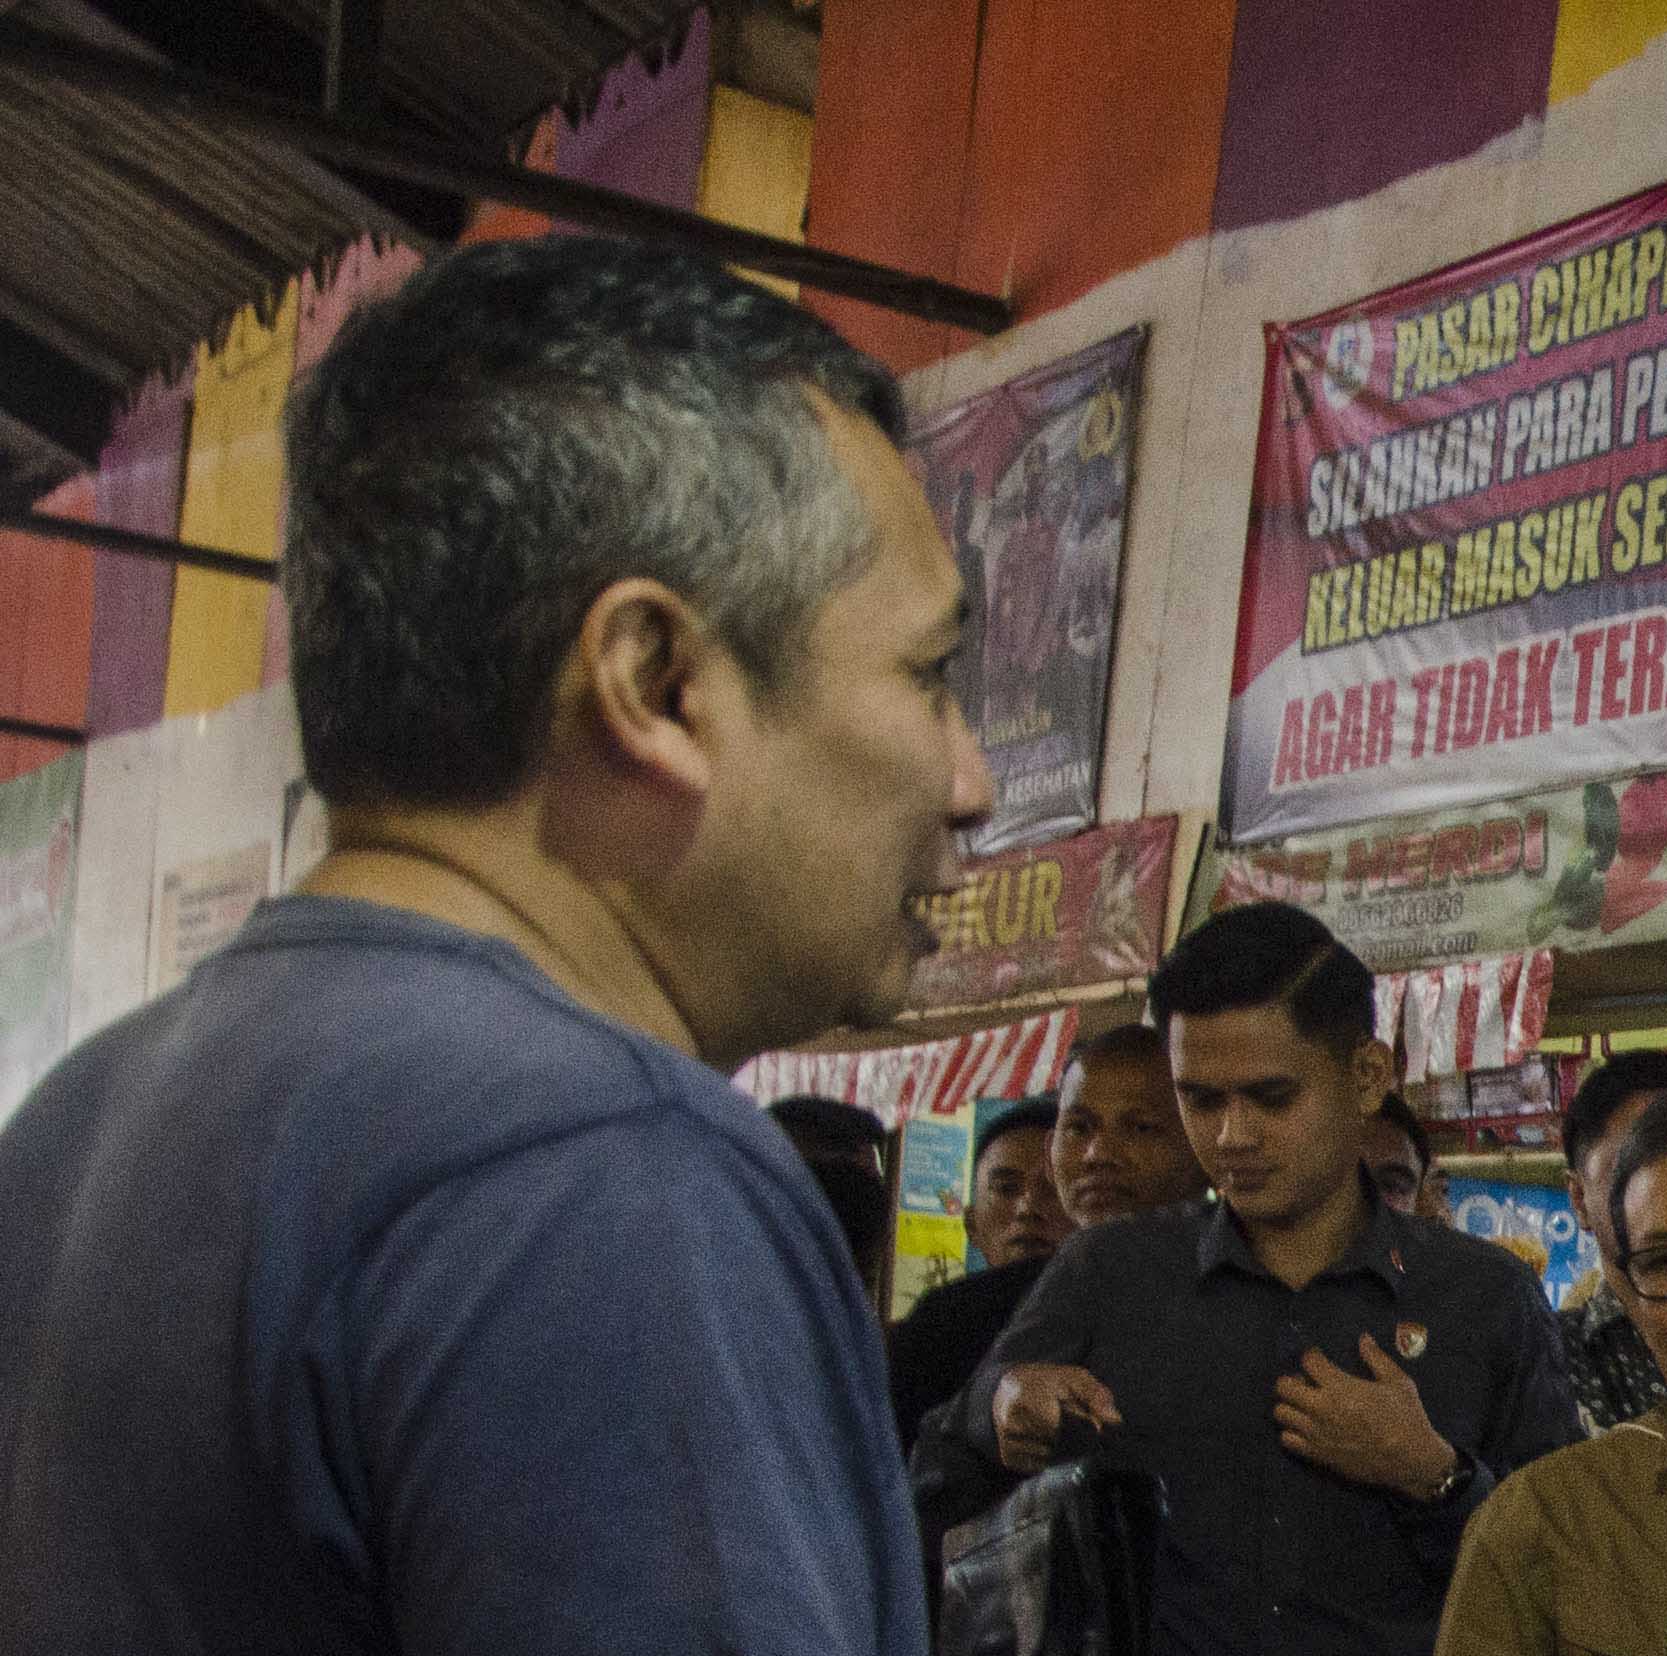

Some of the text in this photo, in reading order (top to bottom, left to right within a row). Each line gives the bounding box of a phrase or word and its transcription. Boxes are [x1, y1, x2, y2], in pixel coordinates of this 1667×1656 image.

[1391, 278, 1522, 402] PASAR
[1501, 364, 1615, 484] PARA
[1302, 540, 1448, 656] KELUAR
[1449, 490, 1611, 615] MASUK
[1273, 677, 1398, 787] AGAR
[1410, 637, 1562, 760] TIDAK
[1342, 810, 1550, 903] HERDI
